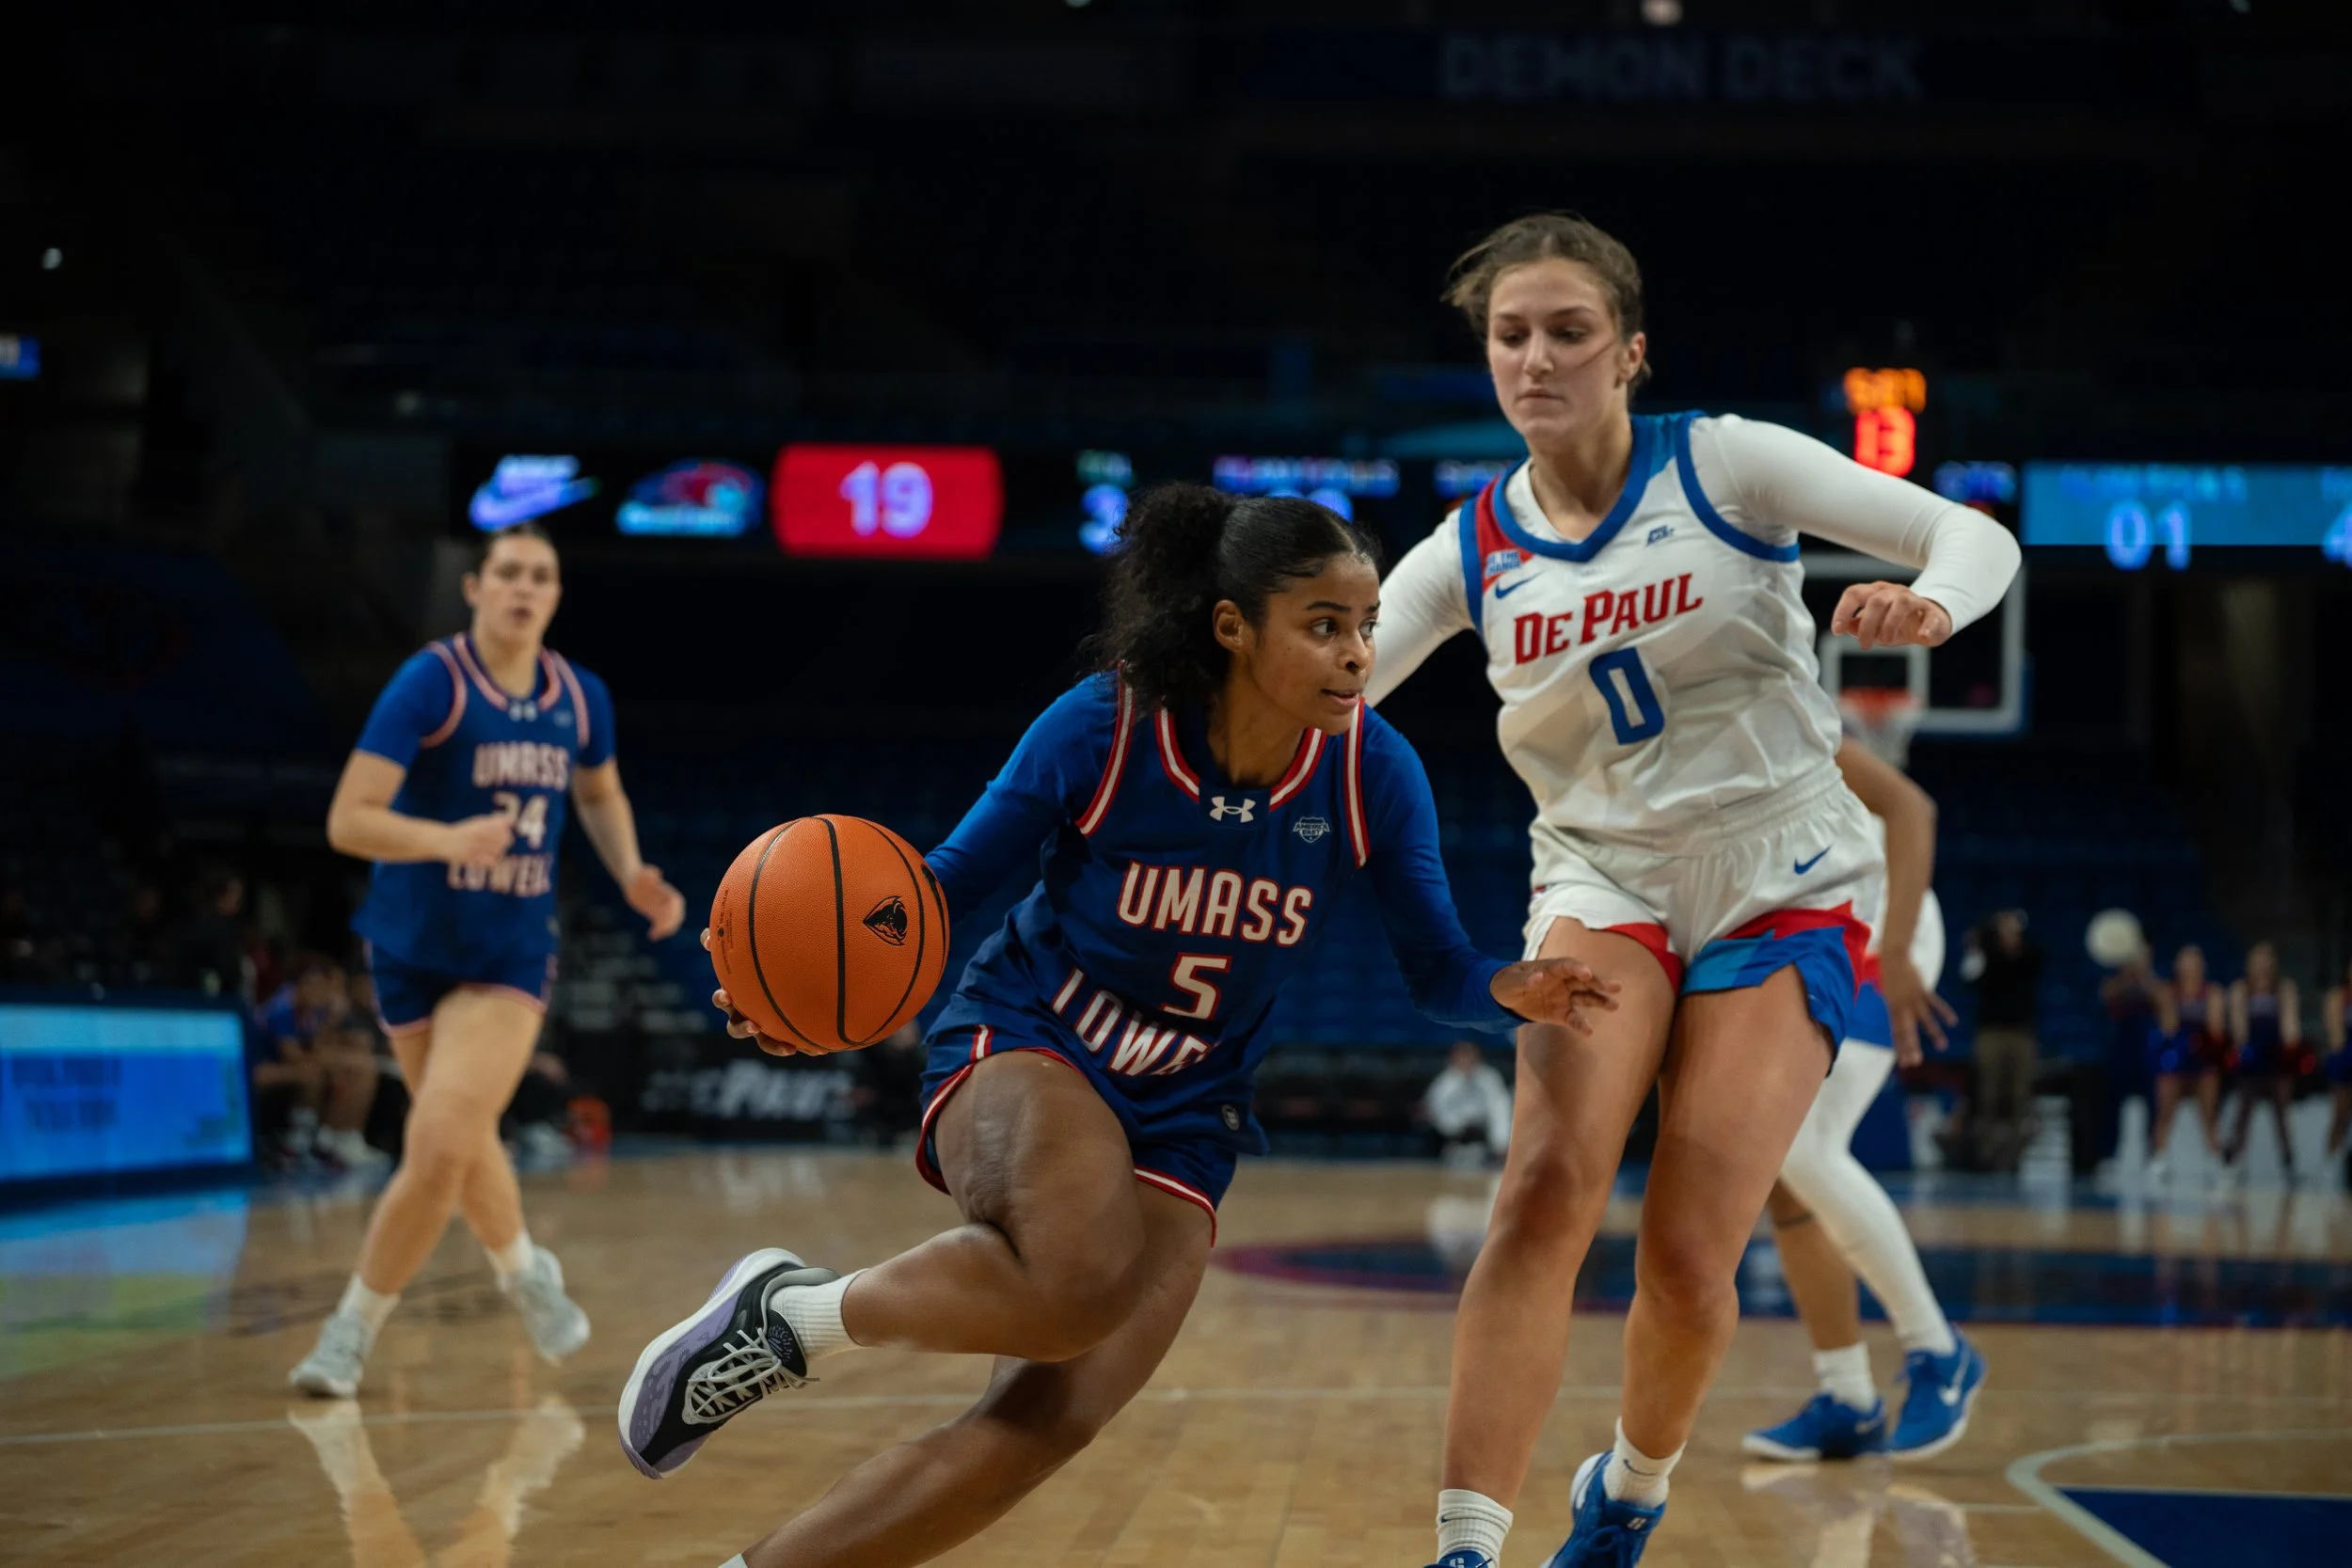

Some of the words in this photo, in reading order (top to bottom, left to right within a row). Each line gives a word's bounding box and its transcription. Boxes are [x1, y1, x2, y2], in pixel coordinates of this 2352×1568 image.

[1440, 34, 1708, 101] DEMON
[1725, 34, 1921, 101] DECK
[841, 461, 933, 537] 19
[2106, 501, 2190, 571] 01
[1589, 645, 1664, 745] 0
[472, 740, 569, 791] UMASS
[1117, 859, 1314, 947] UMASS
[1159, 952, 1232, 1020] 5
